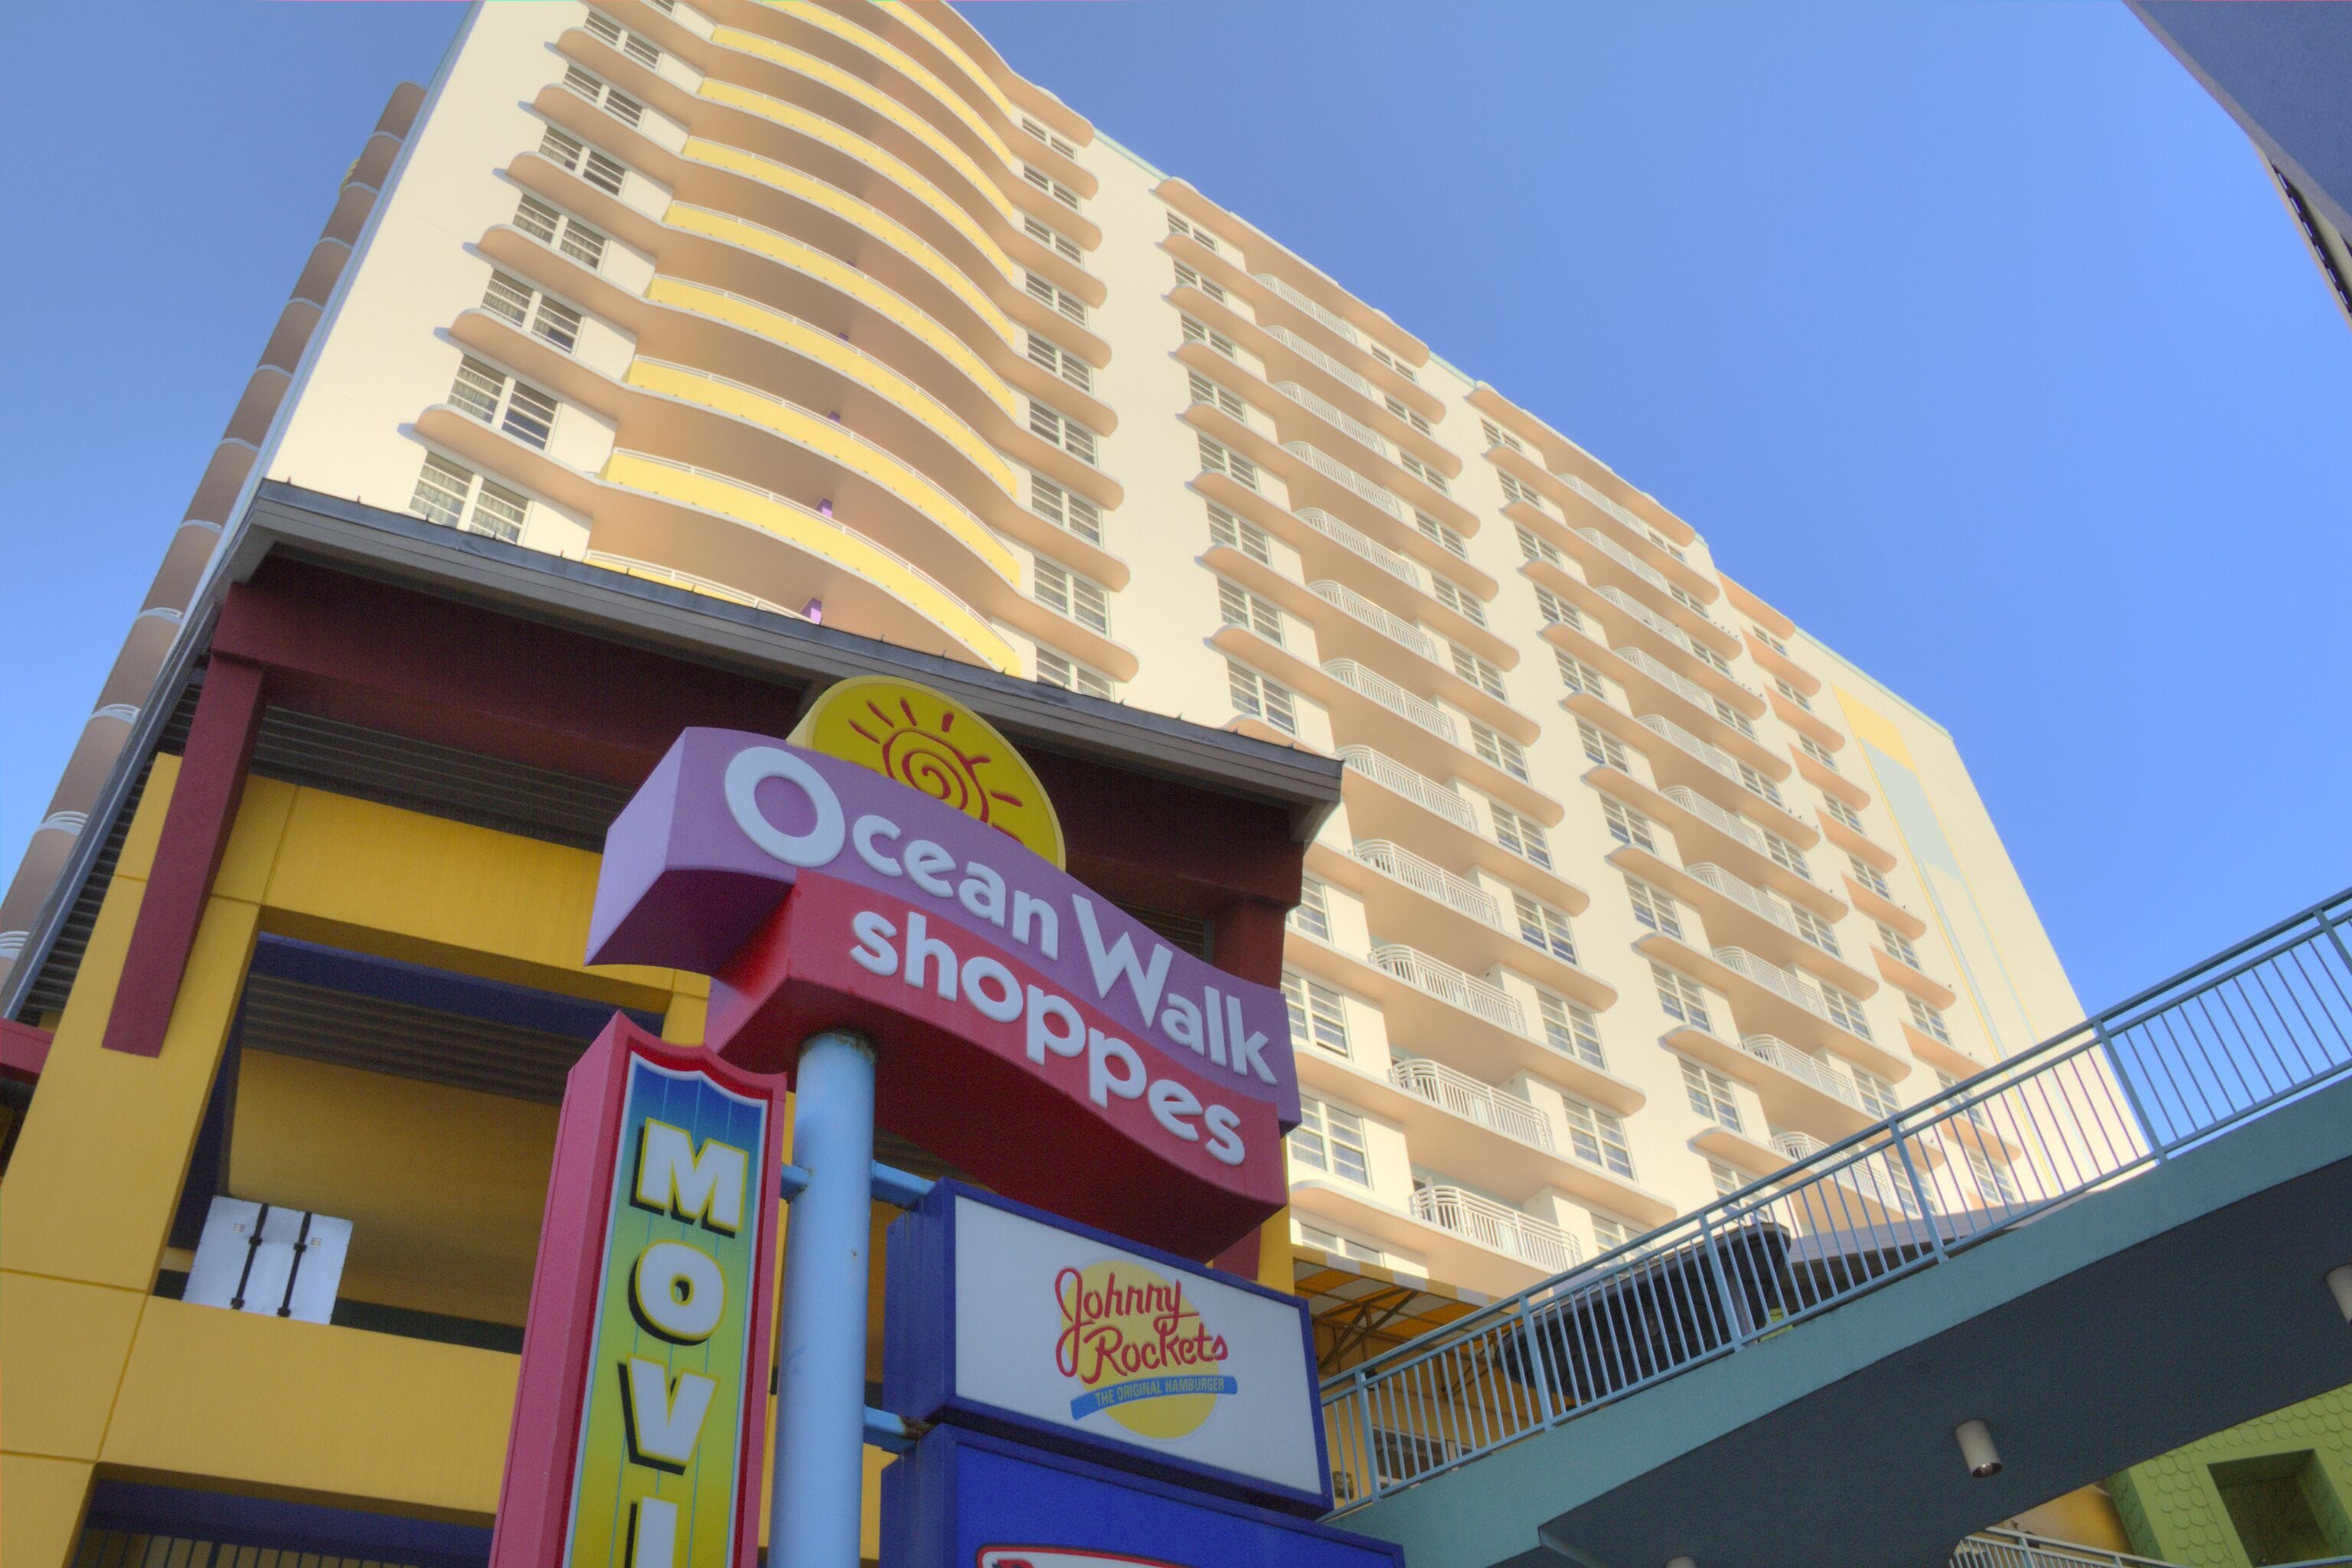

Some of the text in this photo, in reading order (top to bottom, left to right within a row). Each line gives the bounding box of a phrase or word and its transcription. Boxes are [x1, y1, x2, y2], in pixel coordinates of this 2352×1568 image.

[724, 746, 1278, 1086] Ocean Walk
[849, 911, 1246, 1166] shoppes
[1055, 1267, 1200, 1377] Johnny
[1080, 1319, 1228, 1384] Rockets
[1094, 1377, 1225, 1407] THE ORIGINAL HAMBURGER
